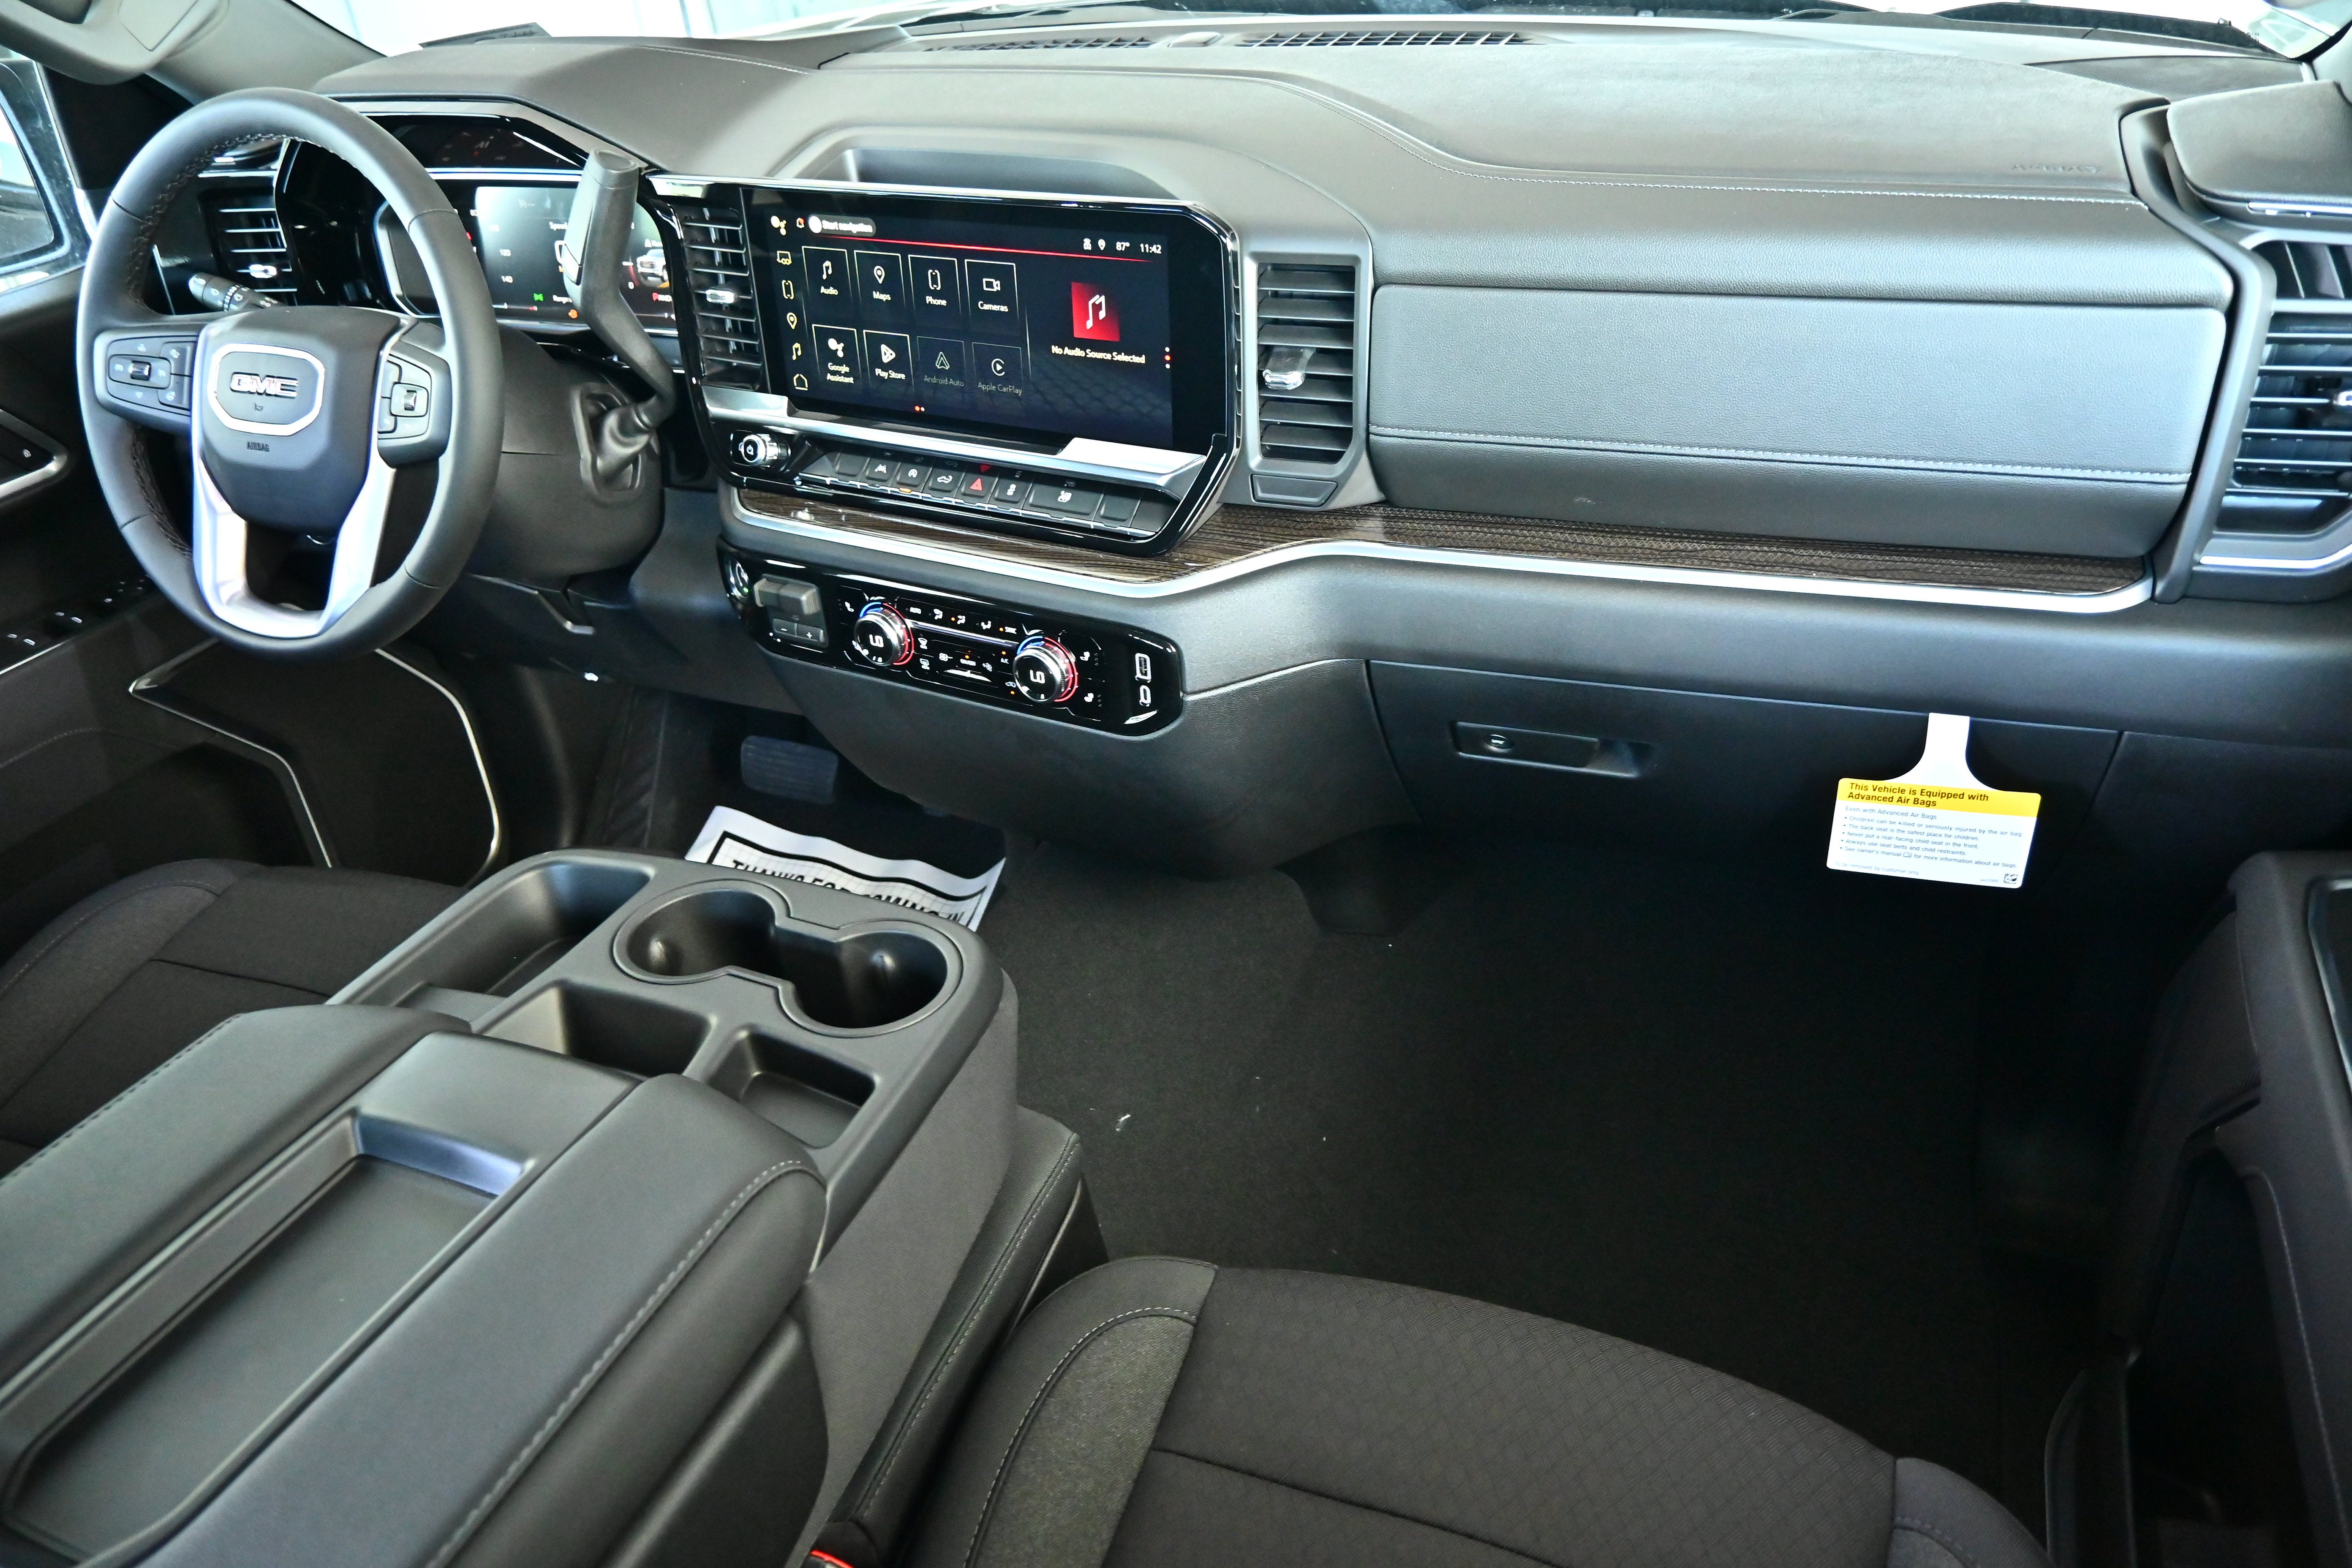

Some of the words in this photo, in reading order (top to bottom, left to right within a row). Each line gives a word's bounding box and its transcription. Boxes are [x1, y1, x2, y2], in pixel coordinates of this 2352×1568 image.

[1140, 243, 1162, 254] 11:42
[820, 286, 838, 295] Audio
[873, 291, 891, 302] Maps
[926, 296, 947, 306] Phone
[978, 301, 1009, 312] Cameras
[1051, 345, 1063, 355] No
[1063, 346, 1086, 357] Audio
[1086, 349, 1112, 360] Source
[1112, 351, 1145, 364] Selected
[828, 363, 850, 373] Google
[826, 373, 854, 384] Assistant
[875, 368, 889, 378] Play
[888, 370, 906, 380] Store
[230, 372, 299, 398] GMC
[924, 375, 948, 385] Android
[949, 379, 964, 387] Auto
[978, 382, 996, 392] Apple
[998, 384, 1022, 396] CarPlay
[247, 441, 270, 452] AIRBAG
[1850, 783, 1868, 791] This
[1872, 785, 1906, 794] Vehicle
[1920, 789, 1965, 800] Equipped
[1968, 793, 1989, 801] with
[1848, 792, 1894, 802] Advanced
[1913, 798, 1937, 807] Bags
